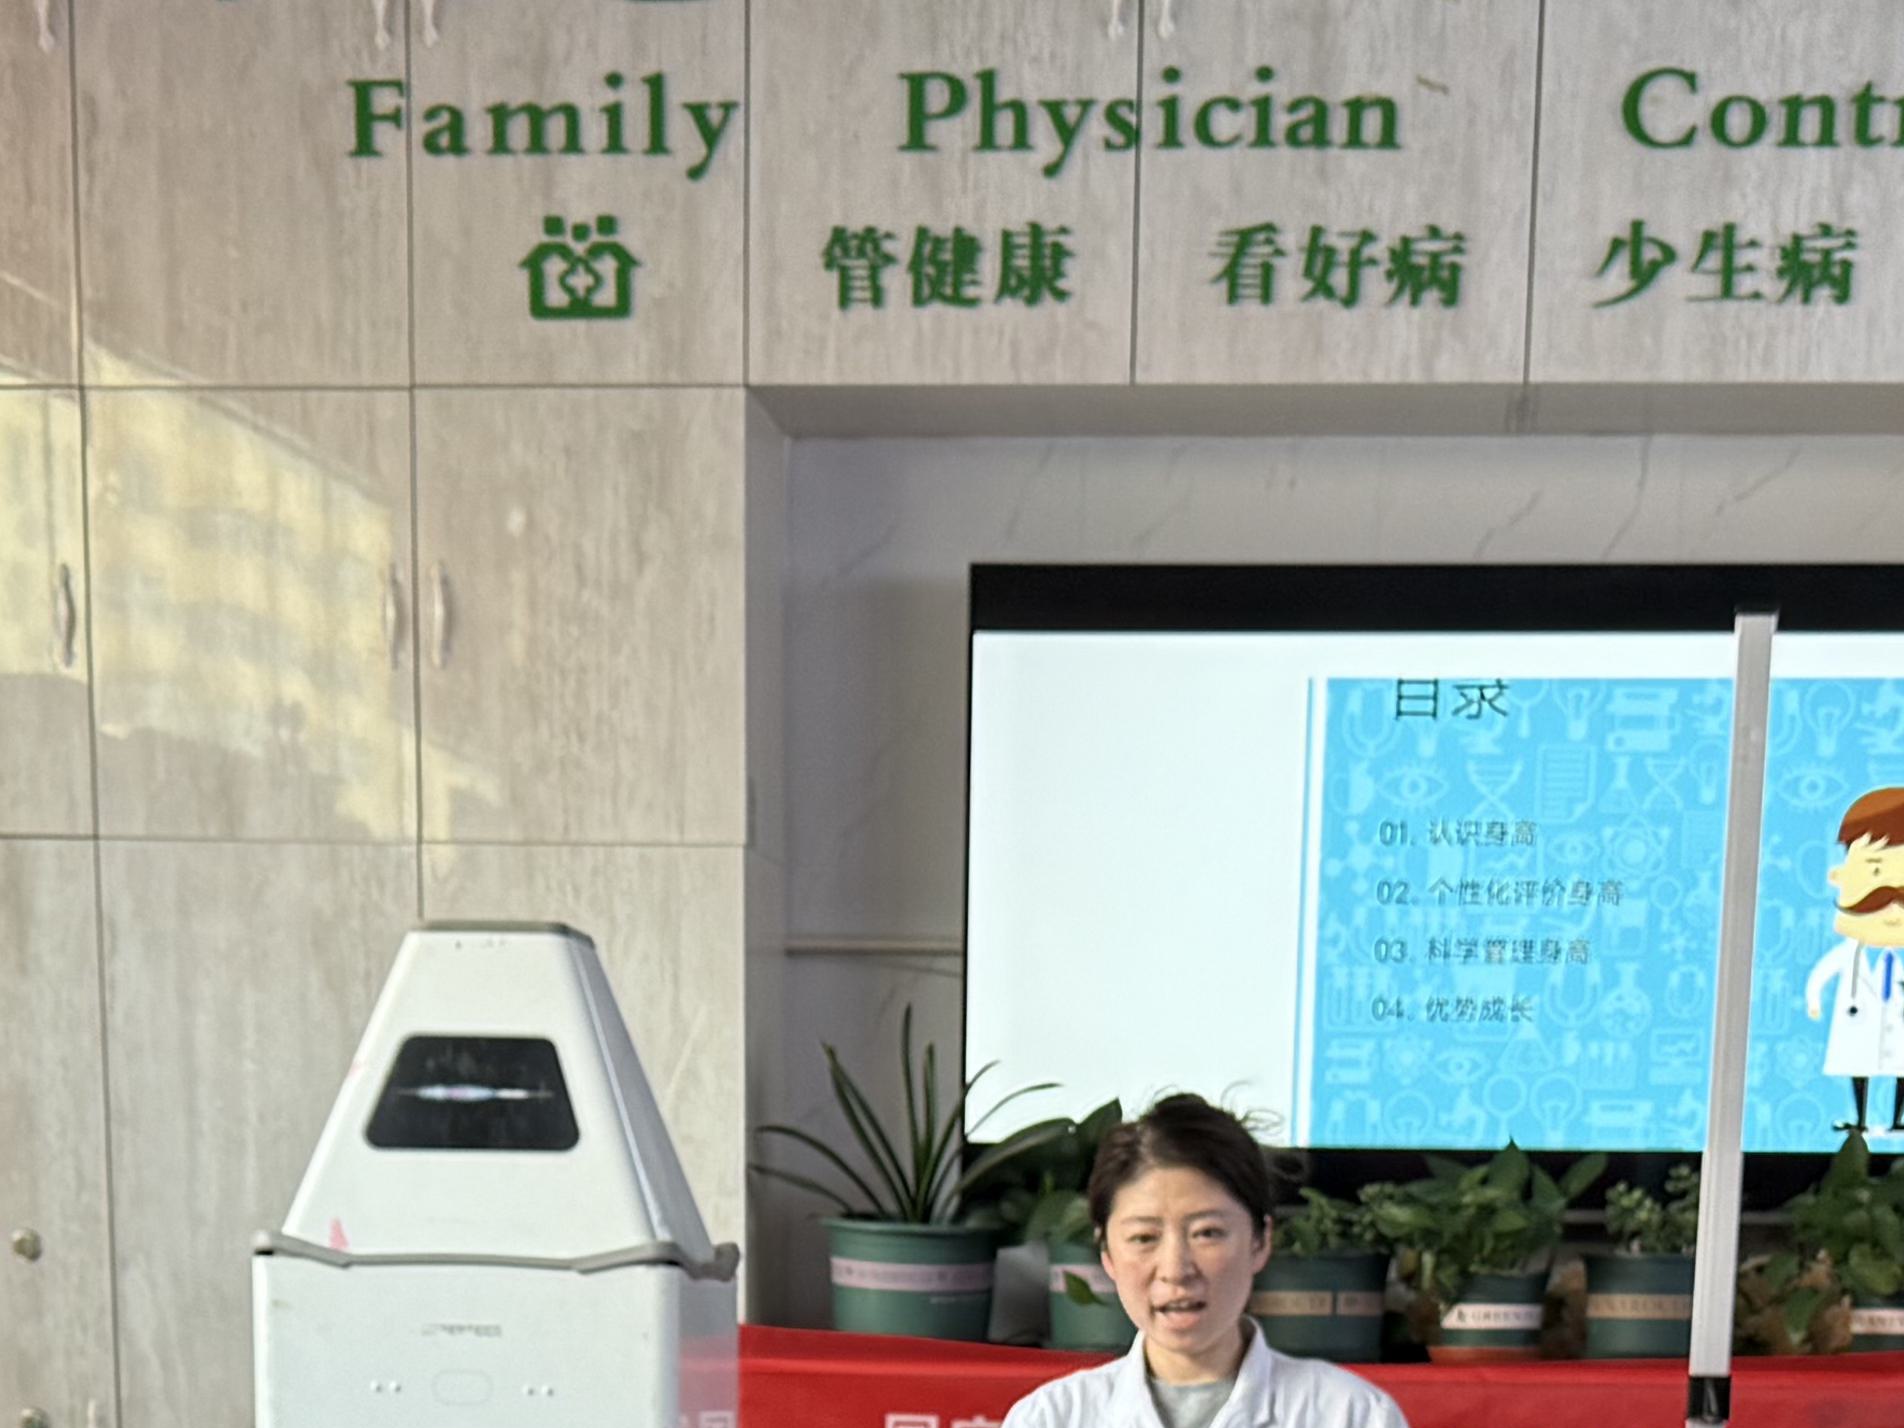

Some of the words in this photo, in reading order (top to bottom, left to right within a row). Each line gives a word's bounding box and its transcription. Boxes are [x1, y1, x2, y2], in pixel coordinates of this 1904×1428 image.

[345, 75, 735, 183] Family
[896, 69, 1404, 177] Physician
[819, 222, 1076, 311] 管健康
[1208, 224, 1466, 310] 看好病
[1592, 220, 1859, 308] 少生病
[1428, 820, 1538, 848] 认识身高
